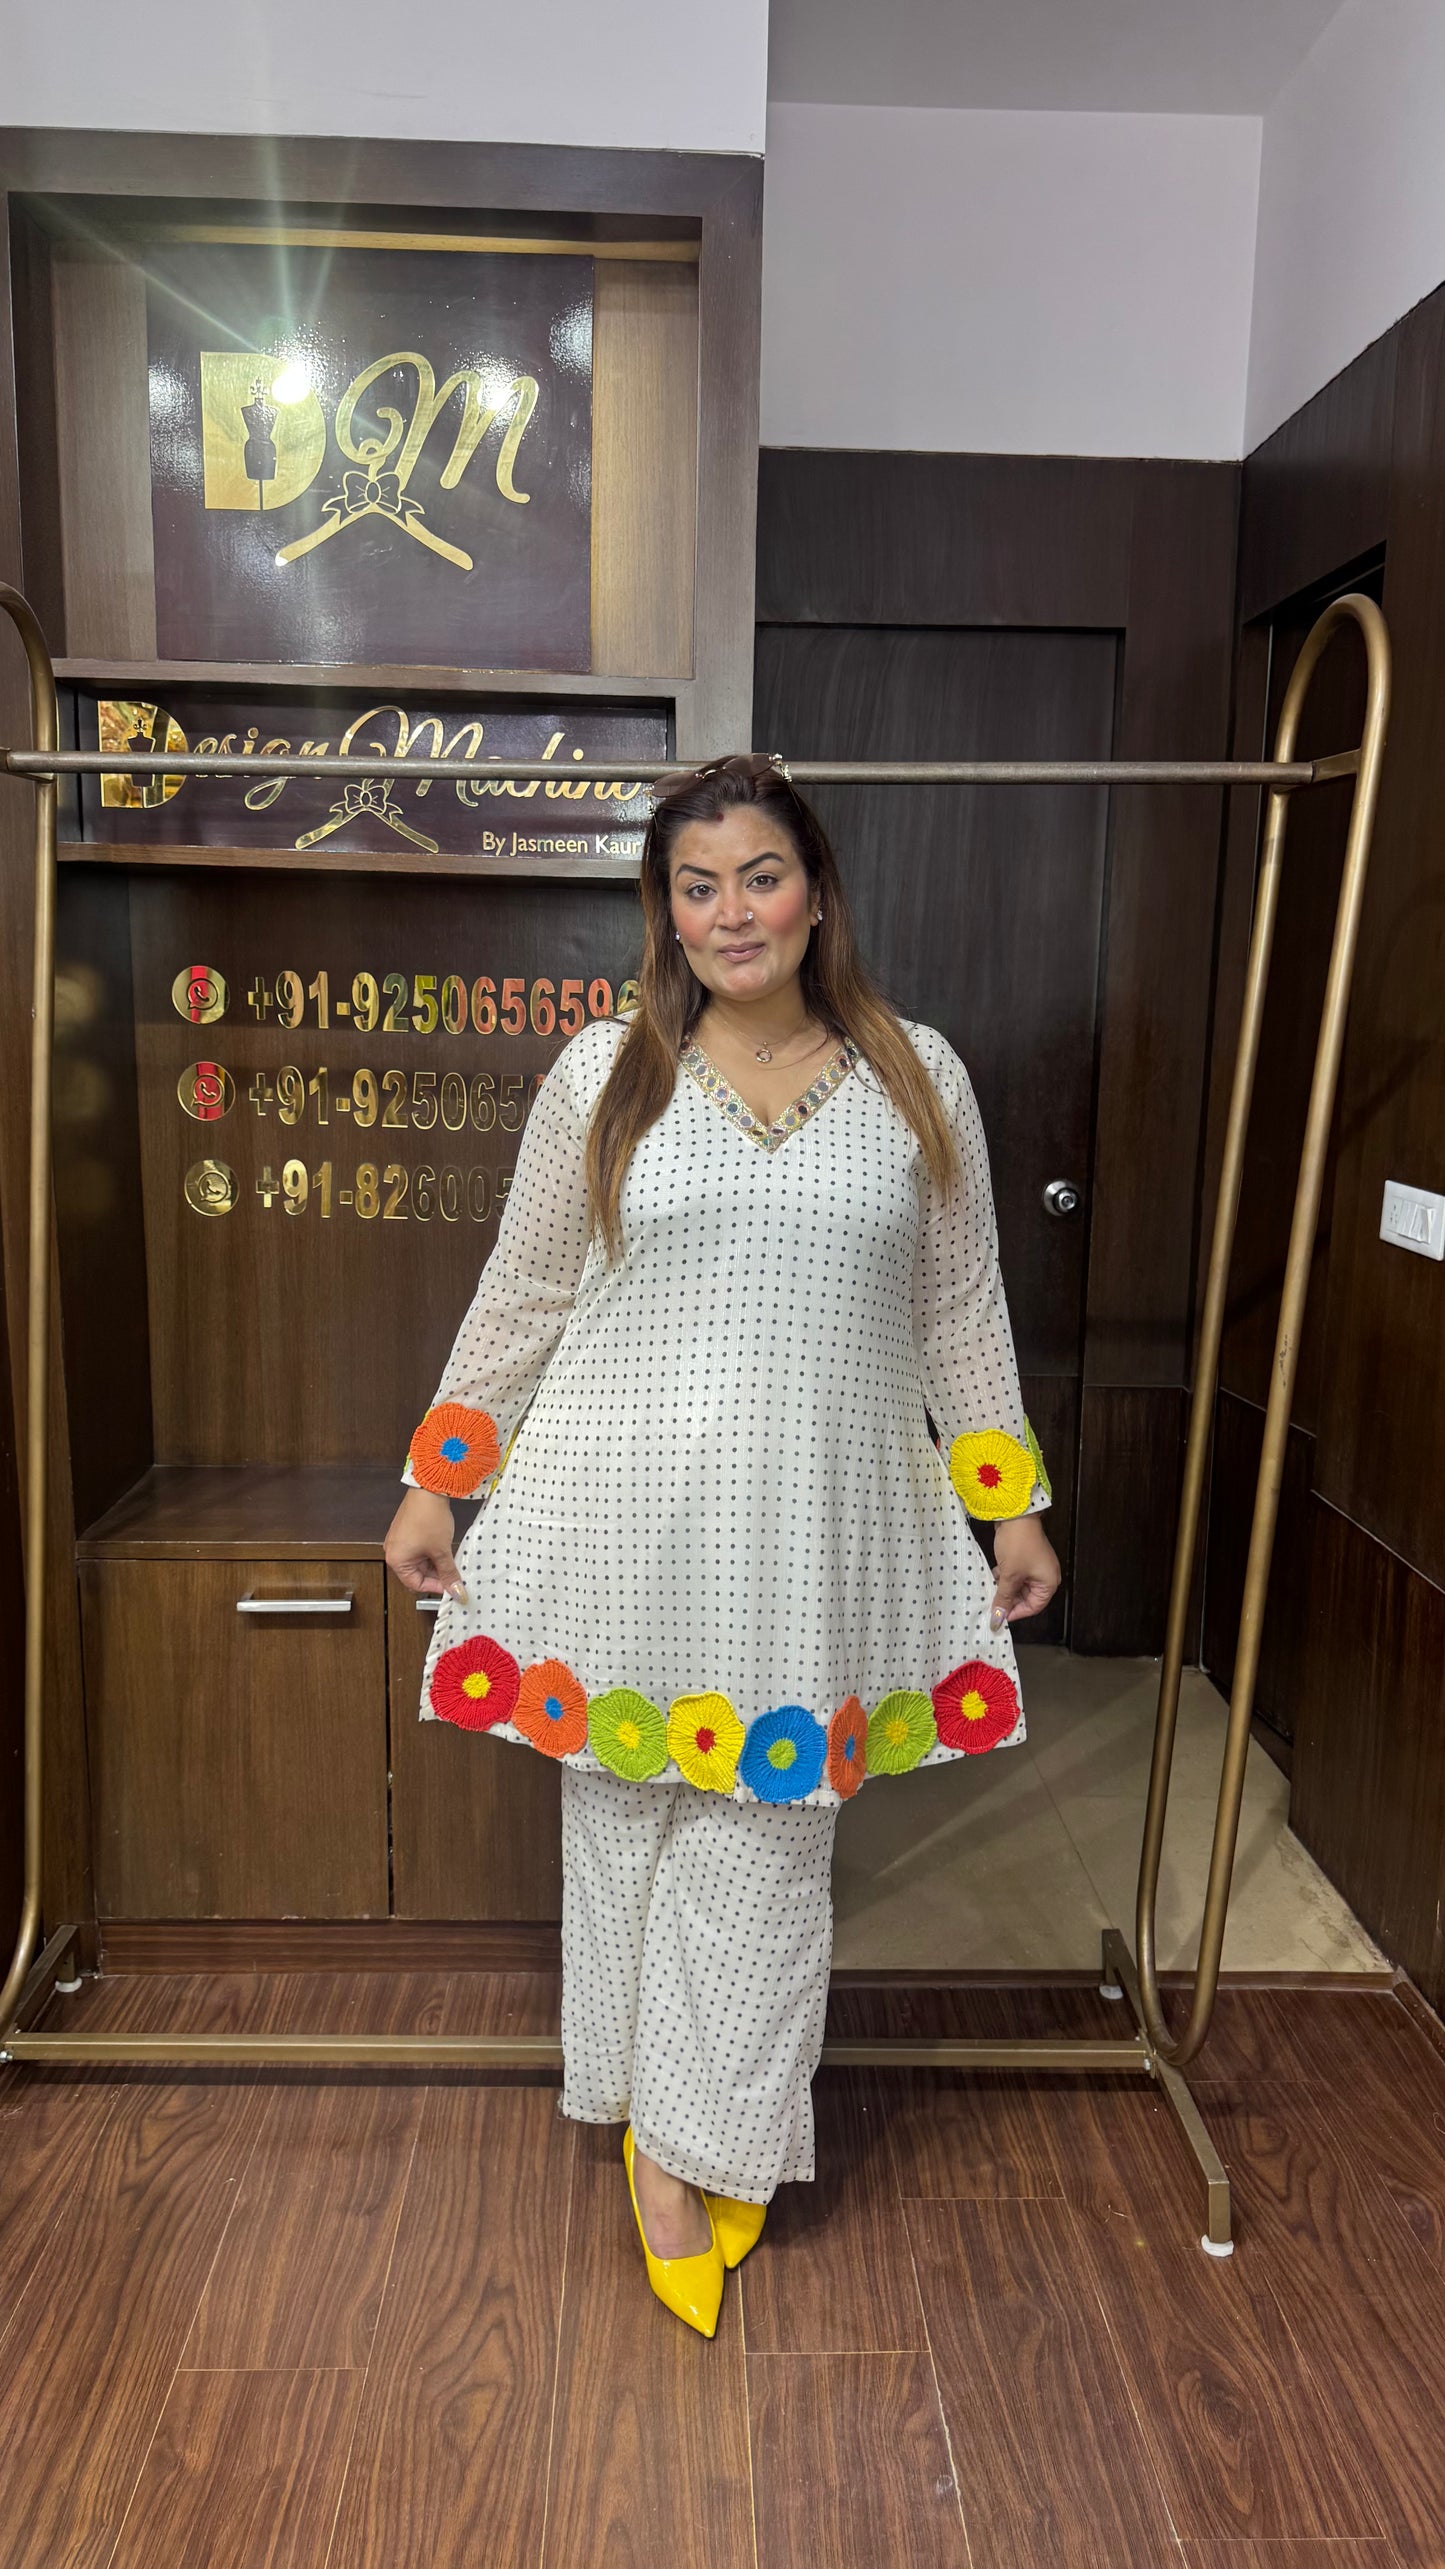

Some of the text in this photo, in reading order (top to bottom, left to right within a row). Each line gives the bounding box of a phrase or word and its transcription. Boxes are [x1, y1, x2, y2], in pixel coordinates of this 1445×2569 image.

[482, 831, 642, 857] By Jasmeen Kaur
